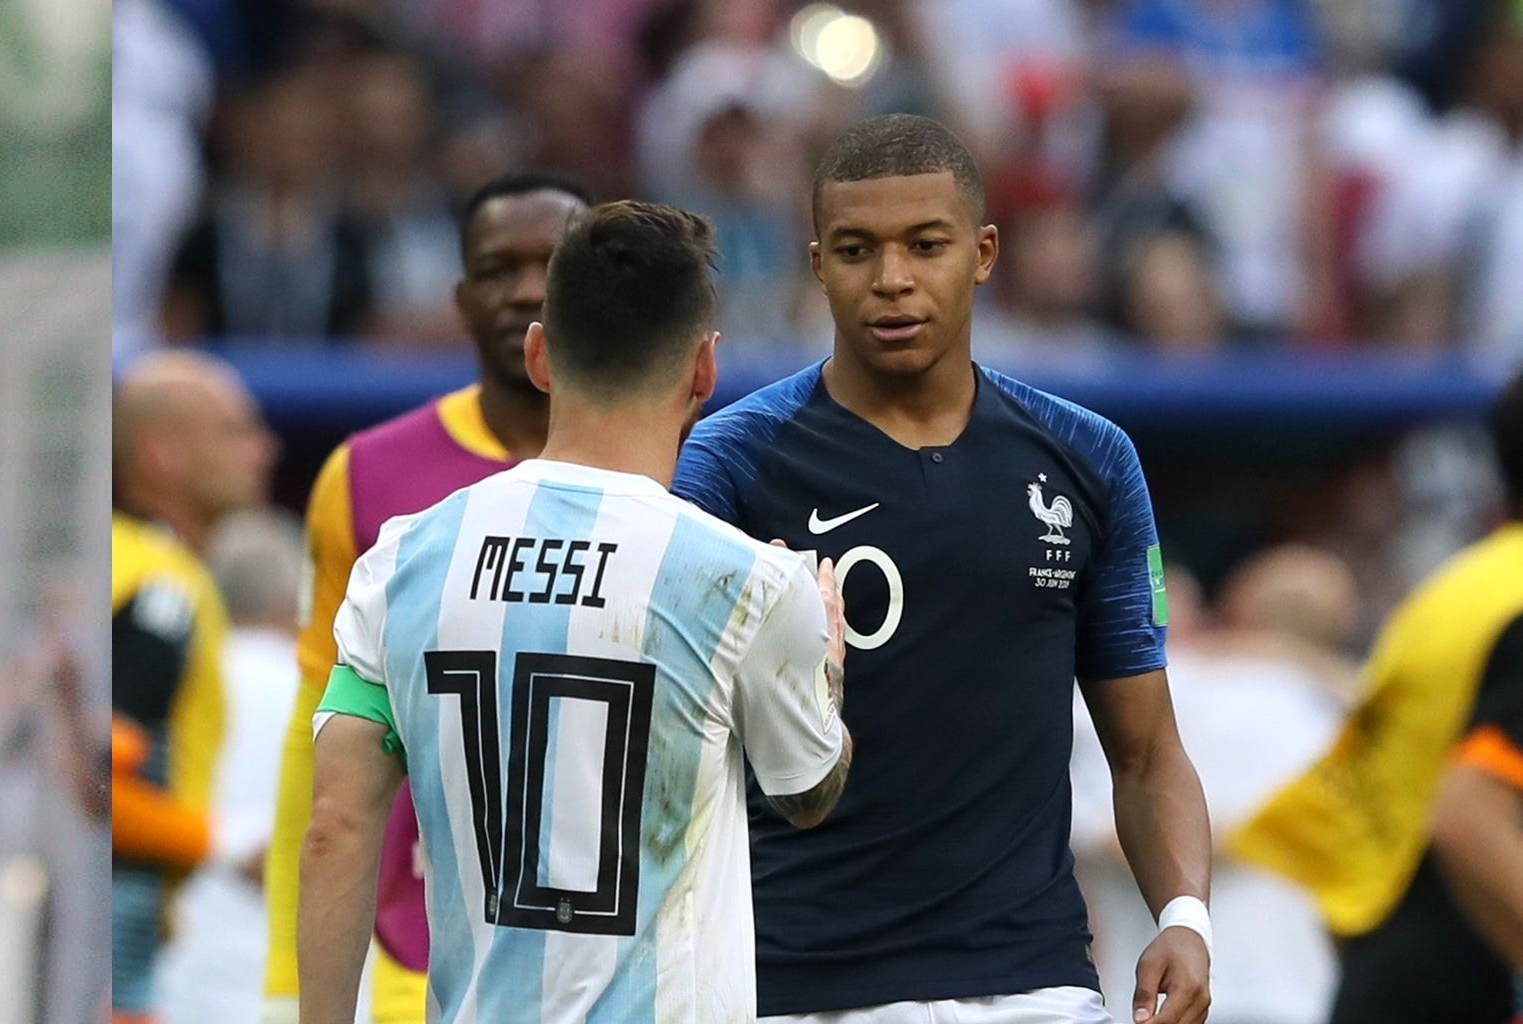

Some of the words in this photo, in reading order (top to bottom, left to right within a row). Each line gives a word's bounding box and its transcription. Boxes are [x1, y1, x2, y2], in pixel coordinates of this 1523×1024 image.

[469, 535, 619, 609] MESSI
[795, 545, 904, 650] 0
[424, 650, 657, 936] 10
